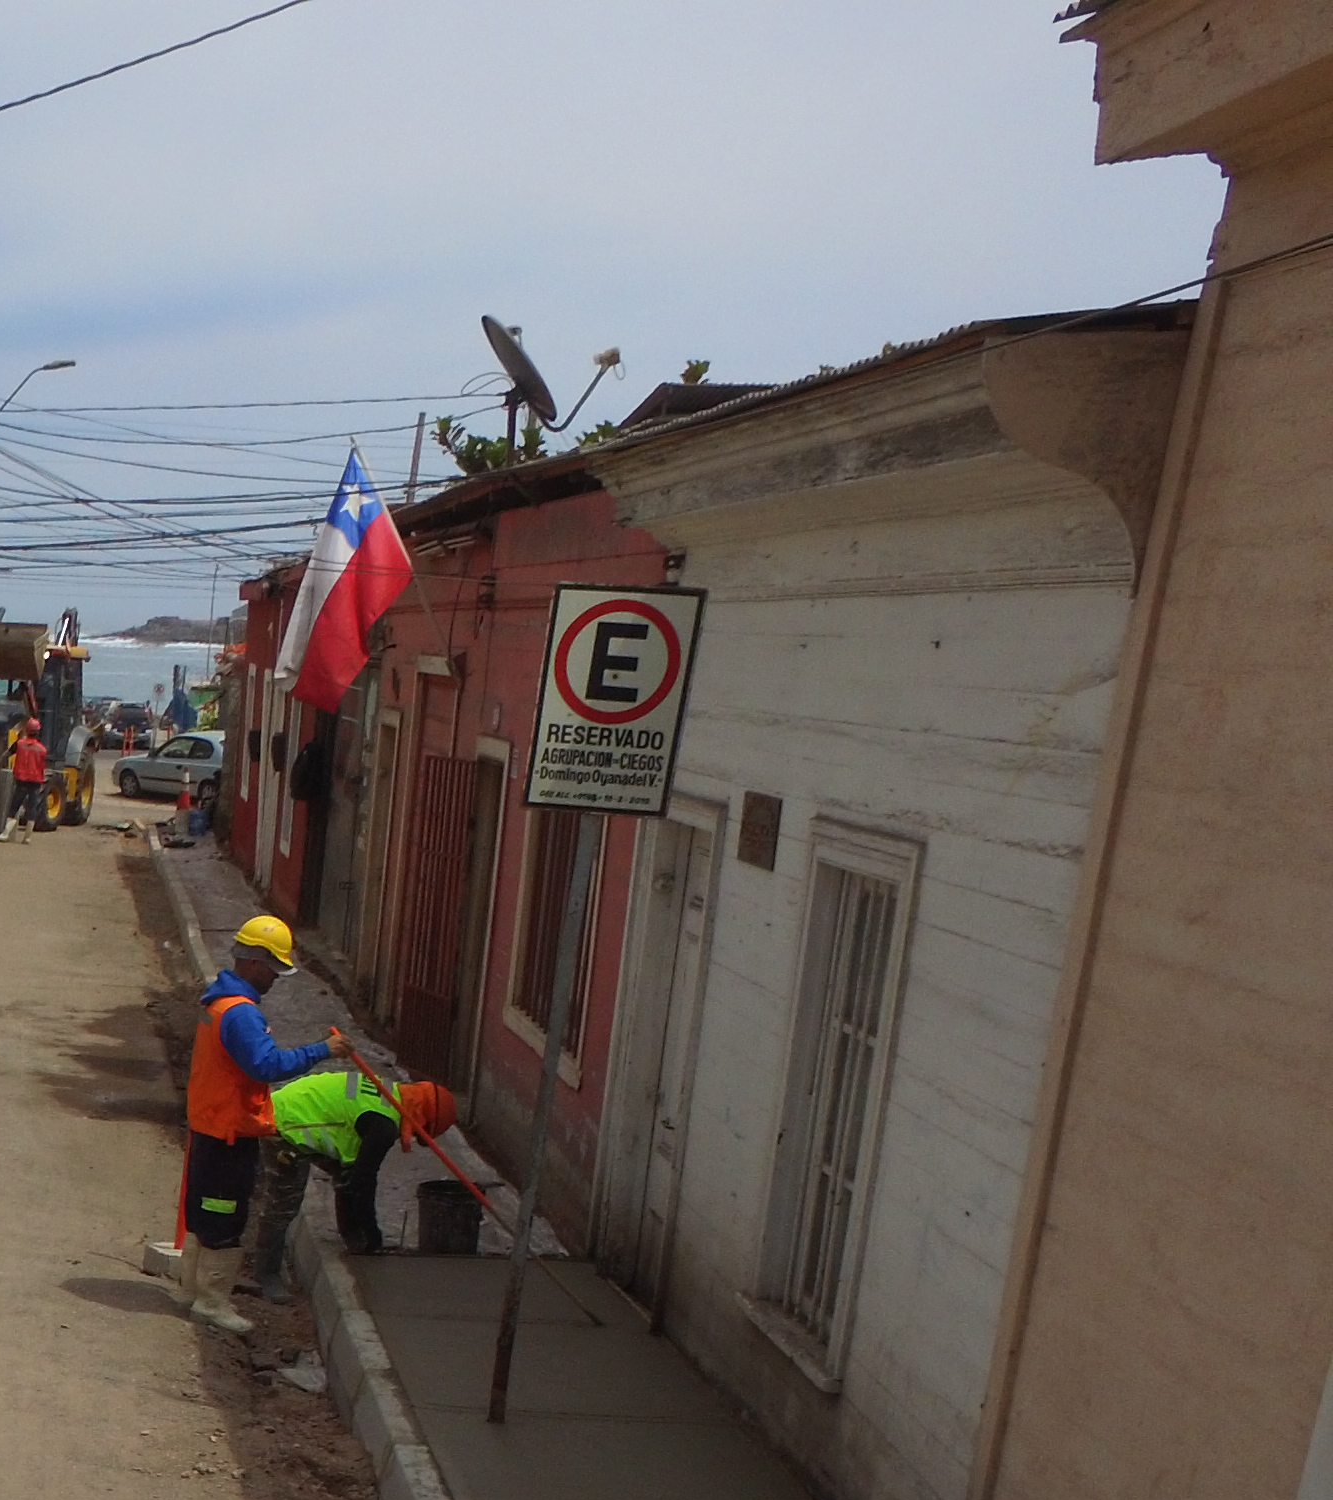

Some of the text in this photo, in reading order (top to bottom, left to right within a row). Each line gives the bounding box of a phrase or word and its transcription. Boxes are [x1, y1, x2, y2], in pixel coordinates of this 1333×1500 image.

[584, 621, 649, 702] E
[546, 723, 664, 750] RESERVADO
[592, 769, 647, 787] Oyanadel
